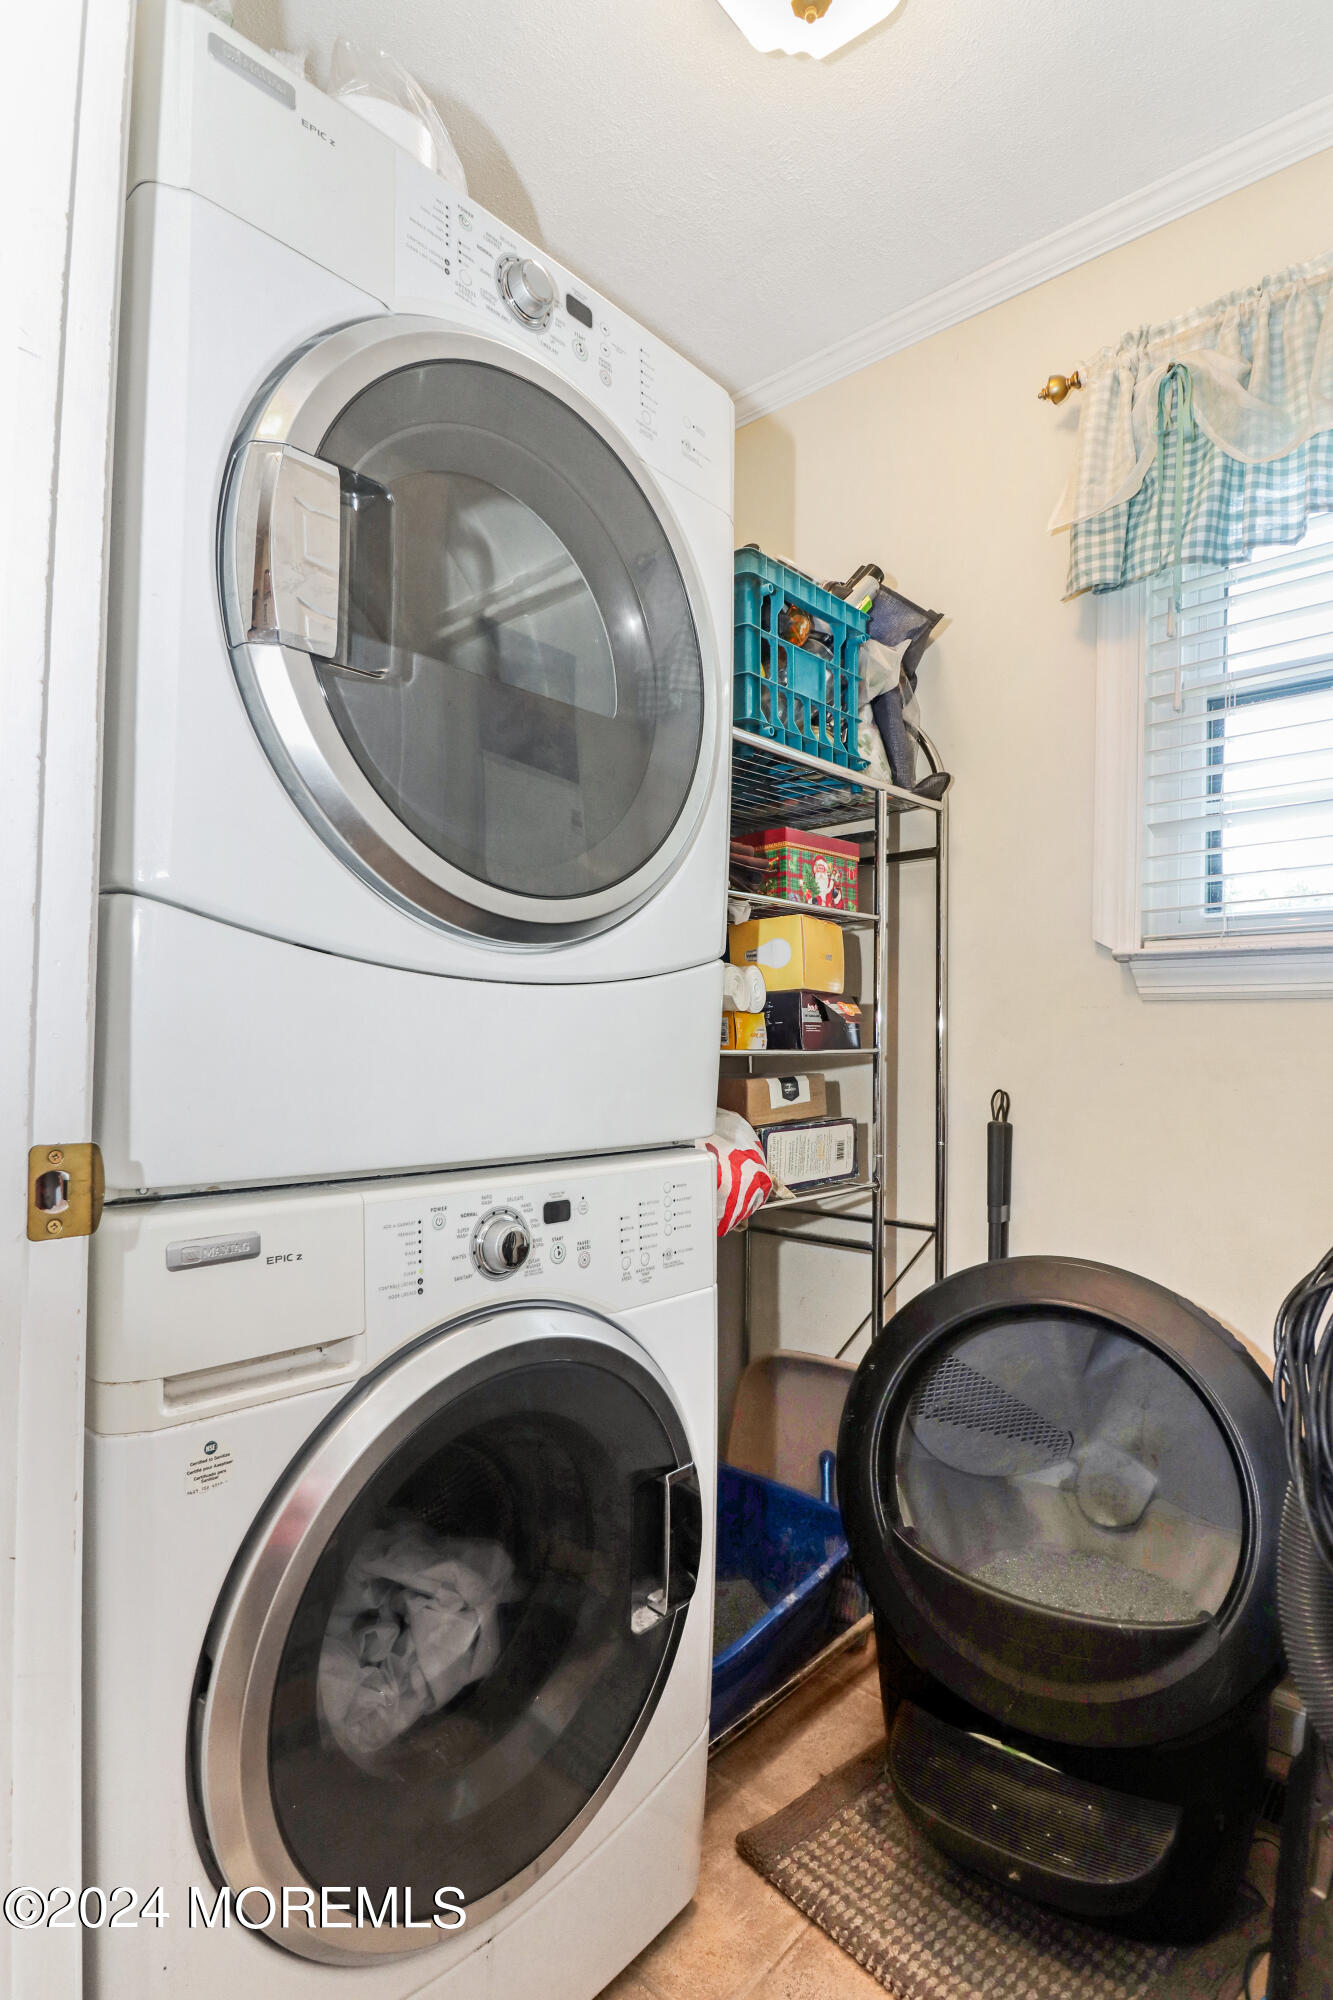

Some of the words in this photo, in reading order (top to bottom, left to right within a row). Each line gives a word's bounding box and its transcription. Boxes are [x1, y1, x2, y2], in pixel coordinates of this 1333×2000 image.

[301, 118, 327, 141] EPIC
[552, 1235, 564, 1243] START
[266, 1253, 293, 1265] EPIC
[452, 1253, 467, 1262] WHITES
[454, 1273, 473, 1282] SANITARY
[190, 1457, 208, 1467] Certified
